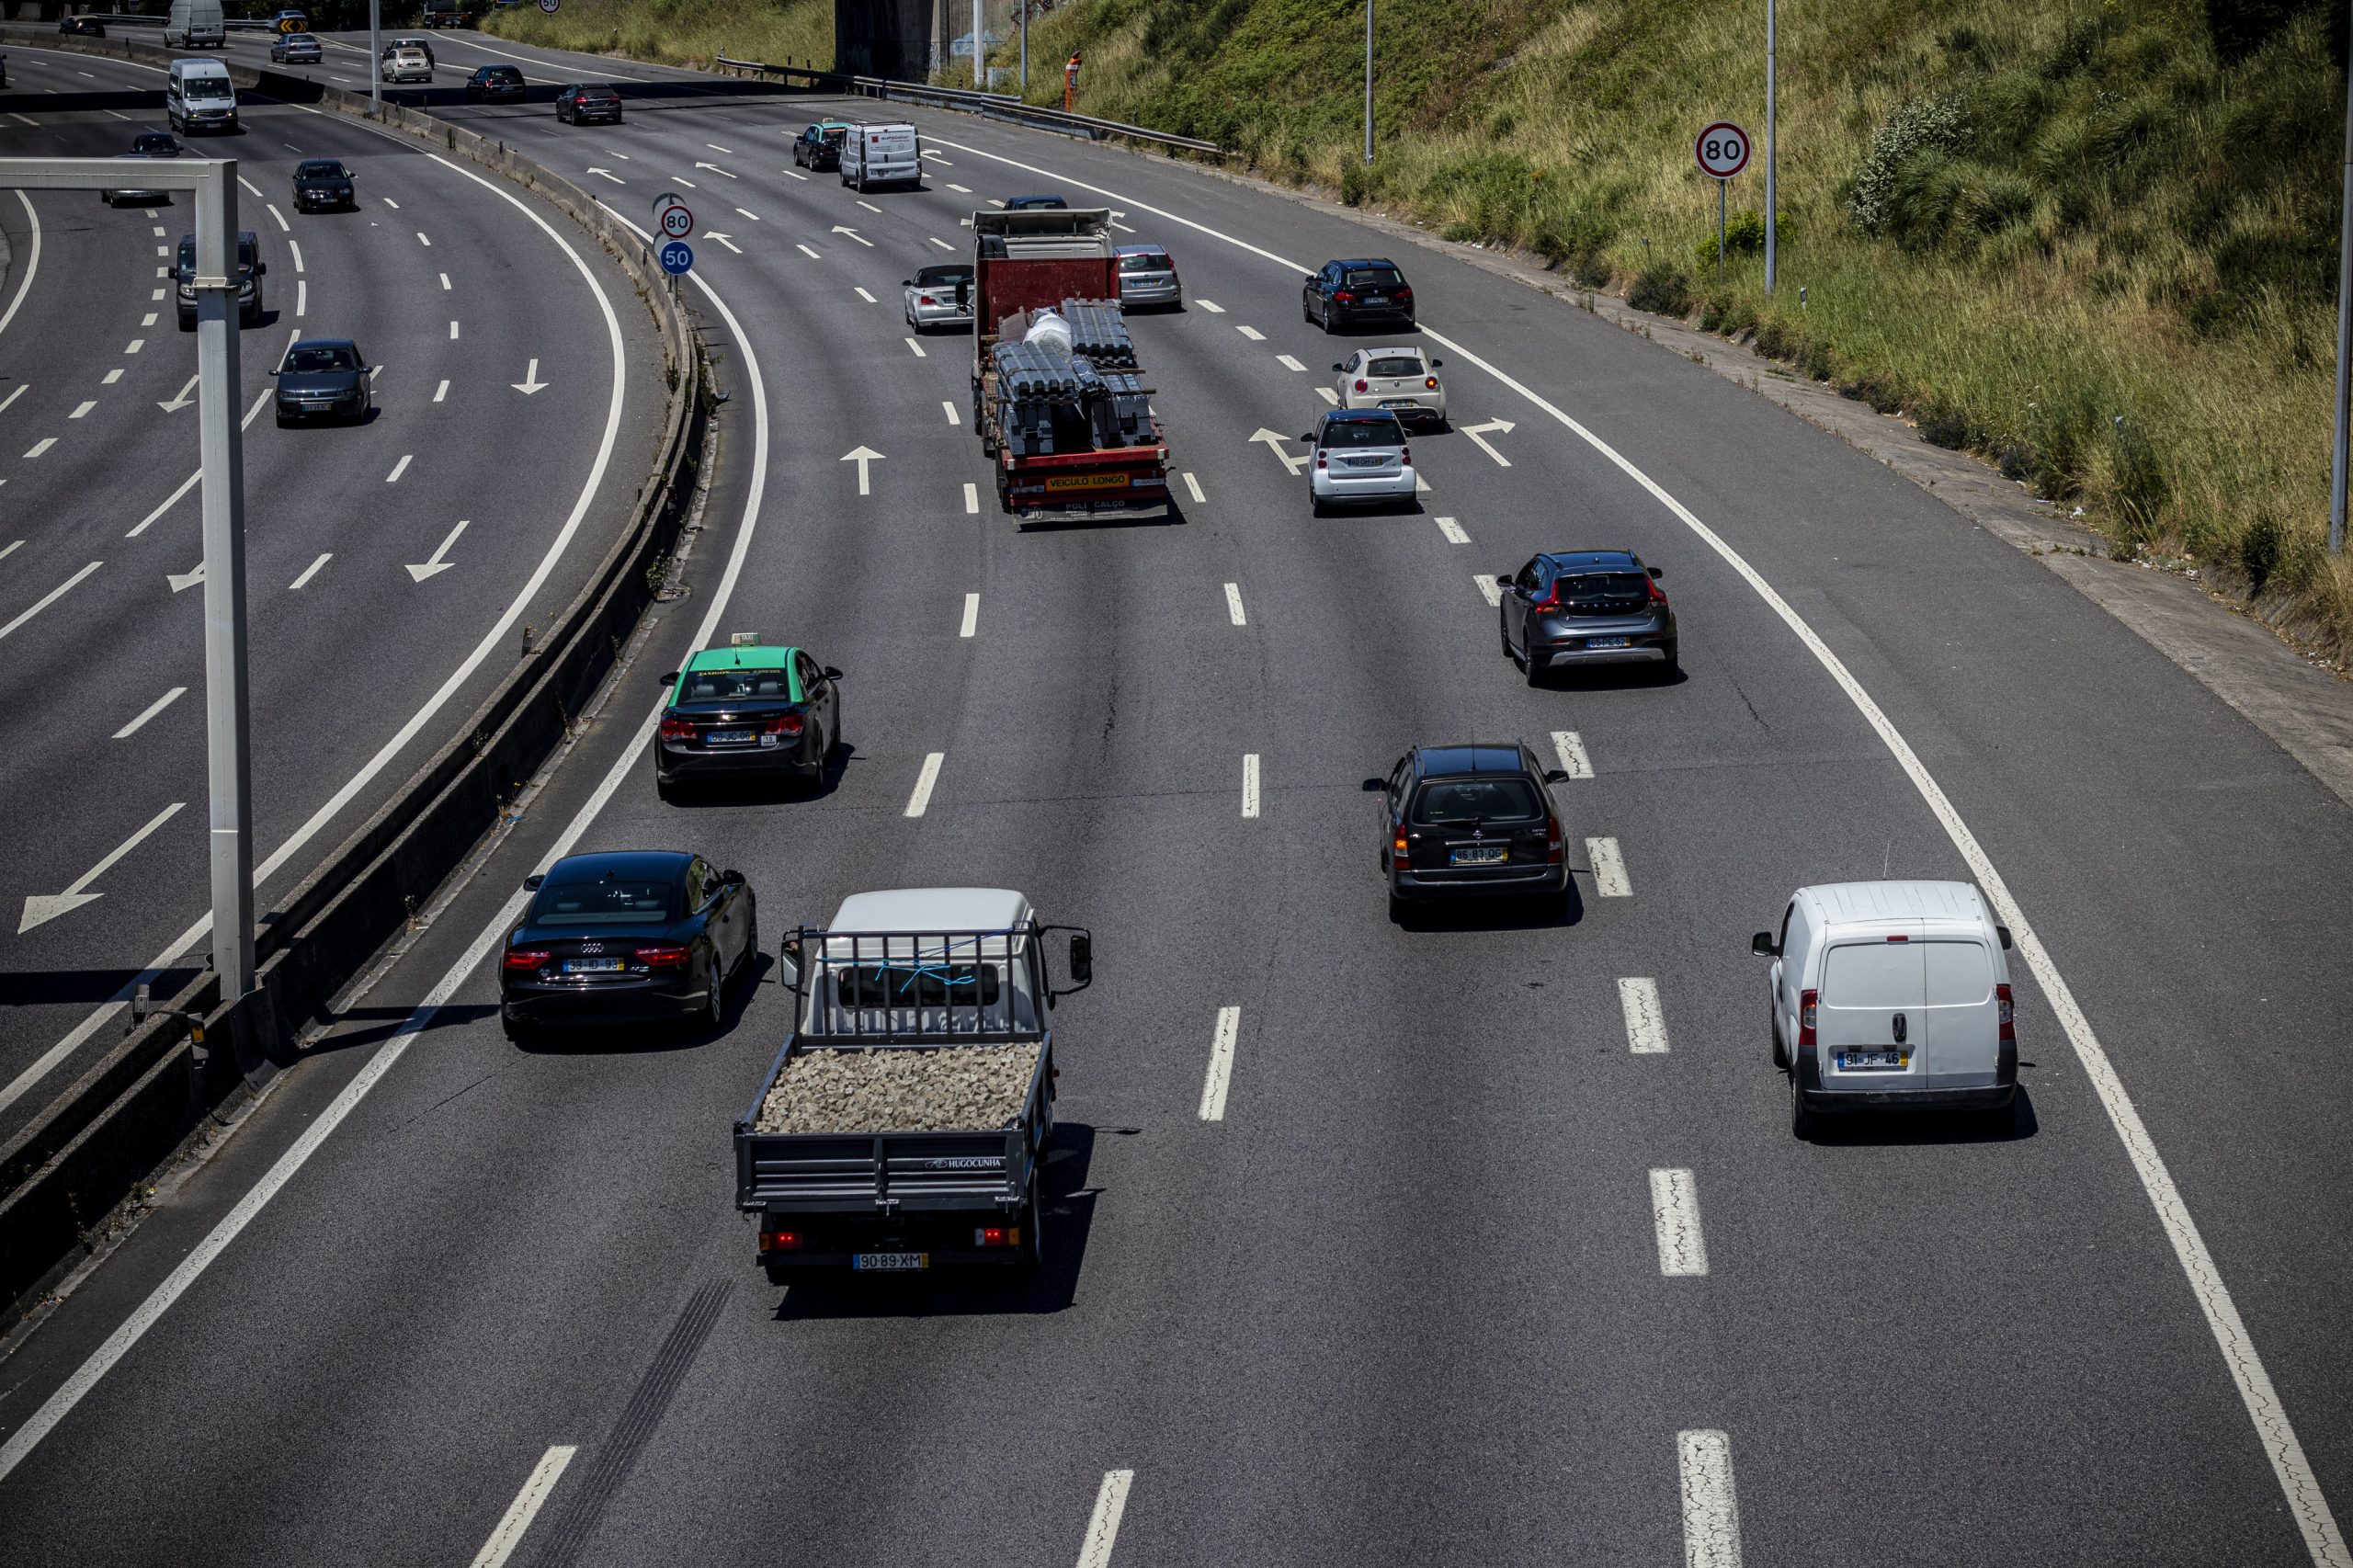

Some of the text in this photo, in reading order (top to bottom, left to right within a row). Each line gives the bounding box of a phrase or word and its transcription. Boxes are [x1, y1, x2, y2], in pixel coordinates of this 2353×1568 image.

[1706, 140, 1740, 160] 80
[666, 215, 688, 229] 80
[665, 250, 688, 266] 50
[1050, 475, 1125, 488] VEICULO LONGO
[1065, 502, 1087, 510] POLI
[949, 1159, 1001, 1168] HUGOCUNHA
